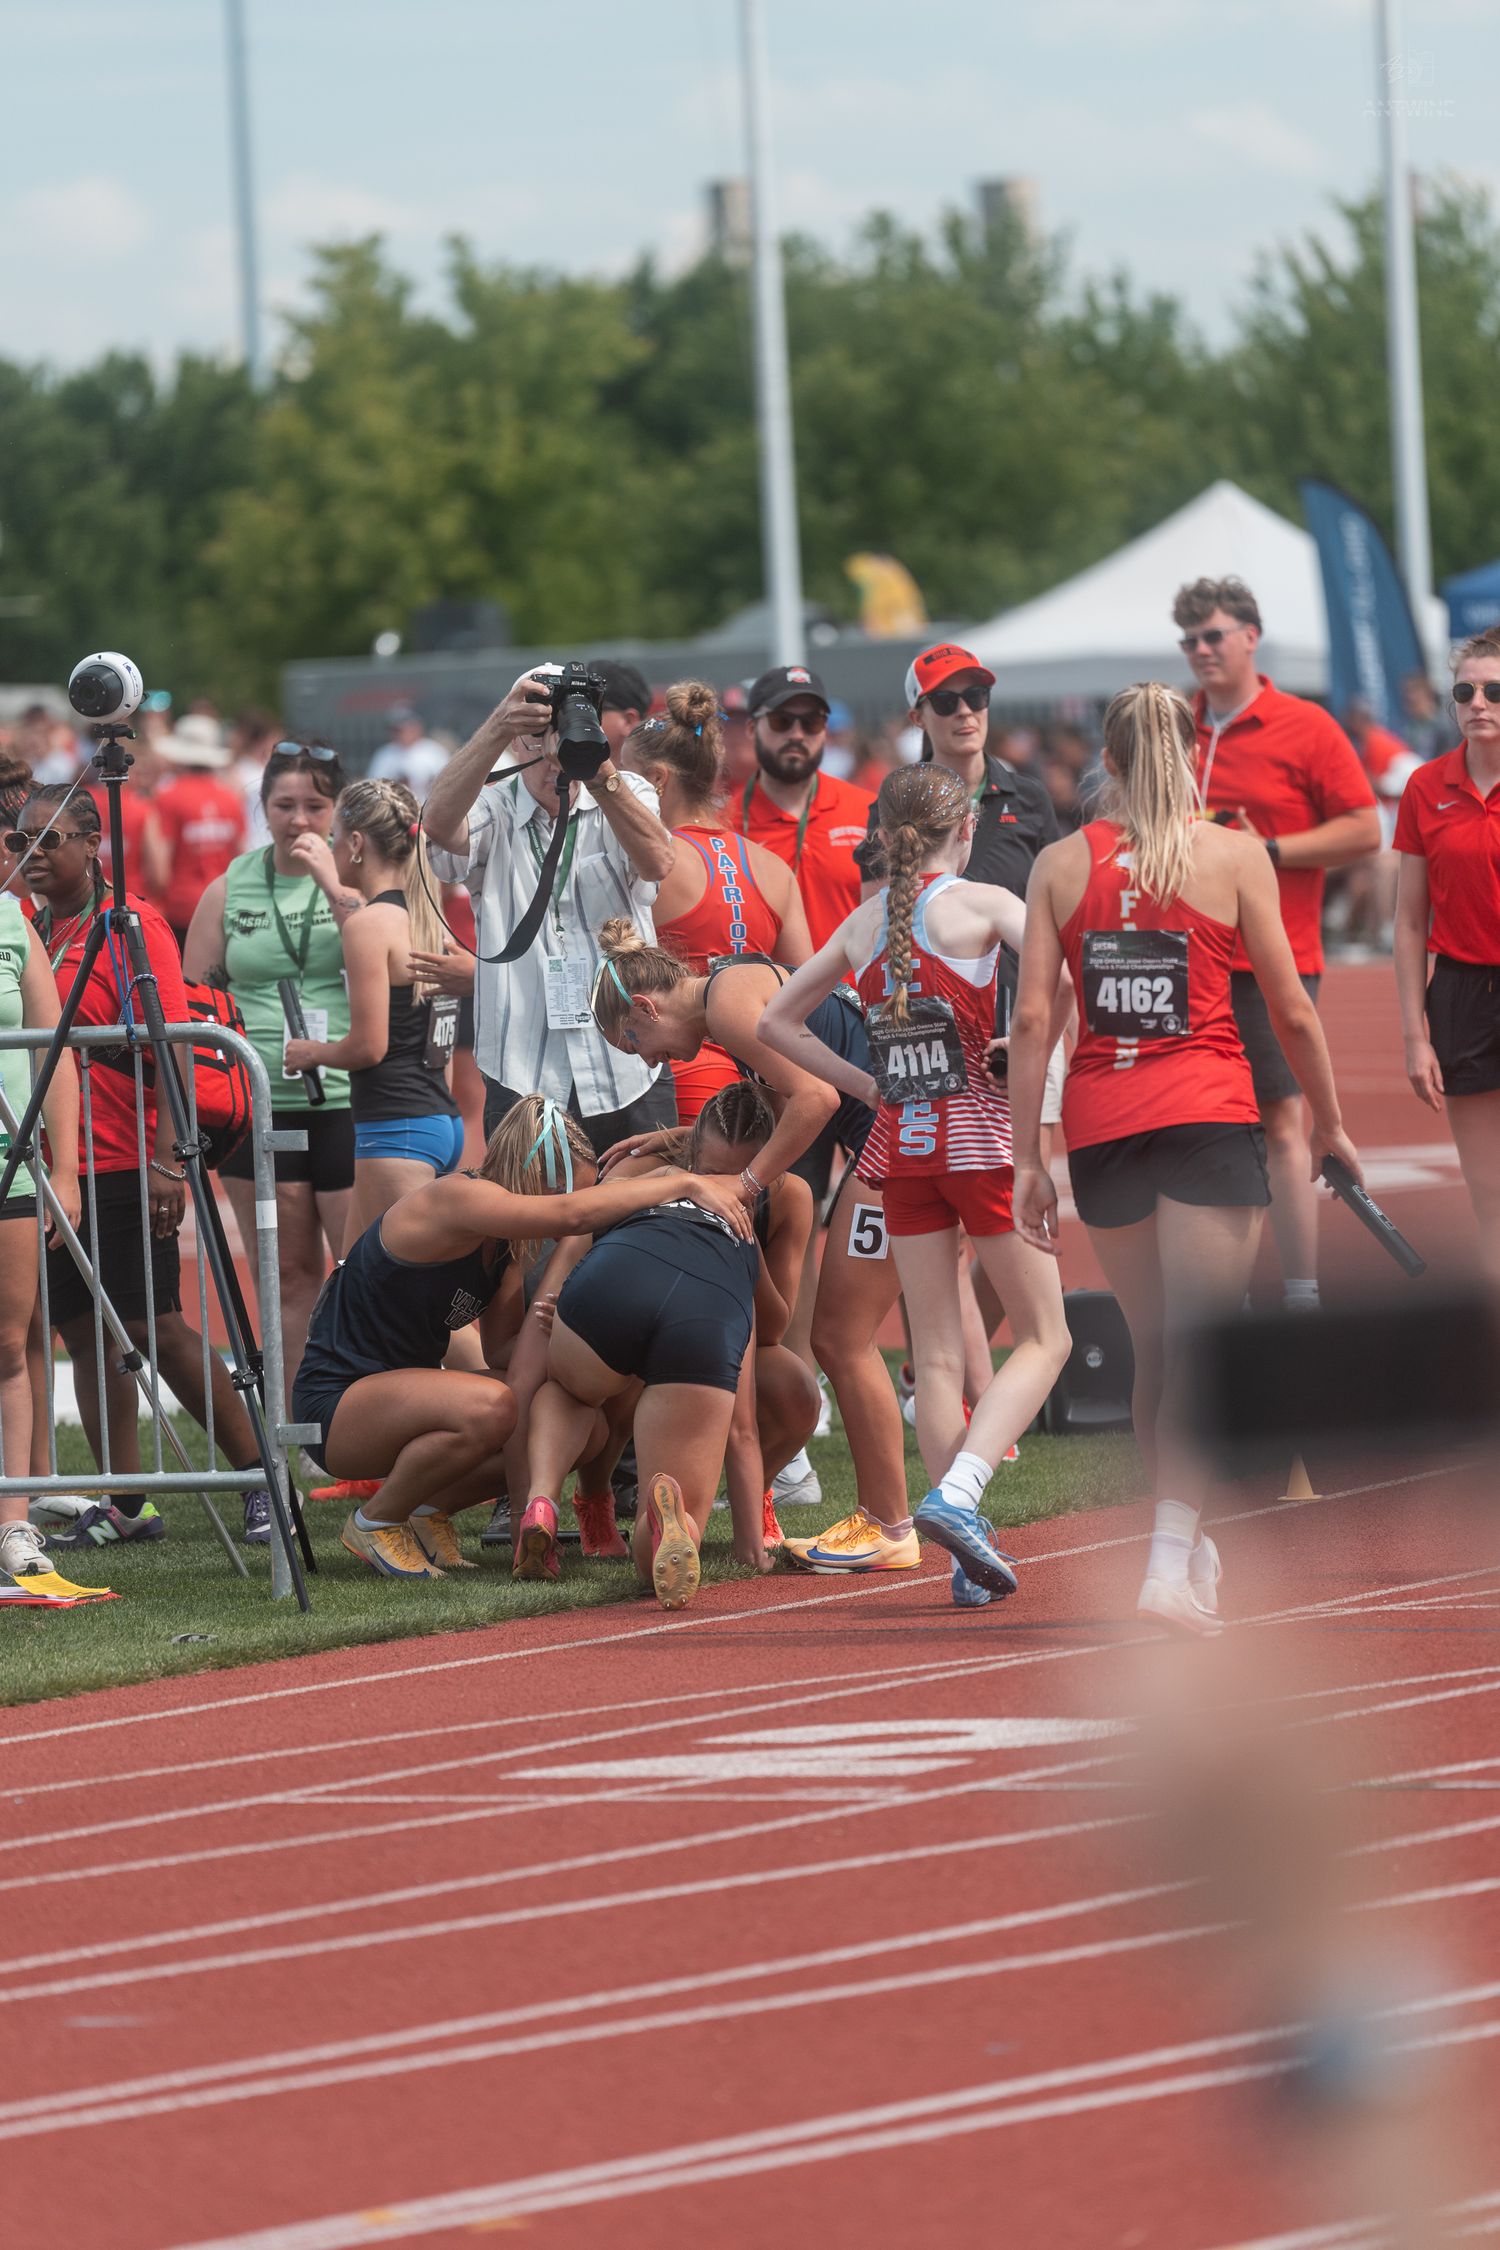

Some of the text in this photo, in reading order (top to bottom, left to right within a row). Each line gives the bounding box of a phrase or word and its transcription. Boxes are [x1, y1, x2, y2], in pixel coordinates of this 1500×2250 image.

[1096, 976, 1174, 1013] 4162
[432, 1014, 457, 1048] 4175
[907, 1027, 946, 1037] Championships
[887, 1039, 949, 1079] 4114
[853, 1207, 884, 1255] 5
